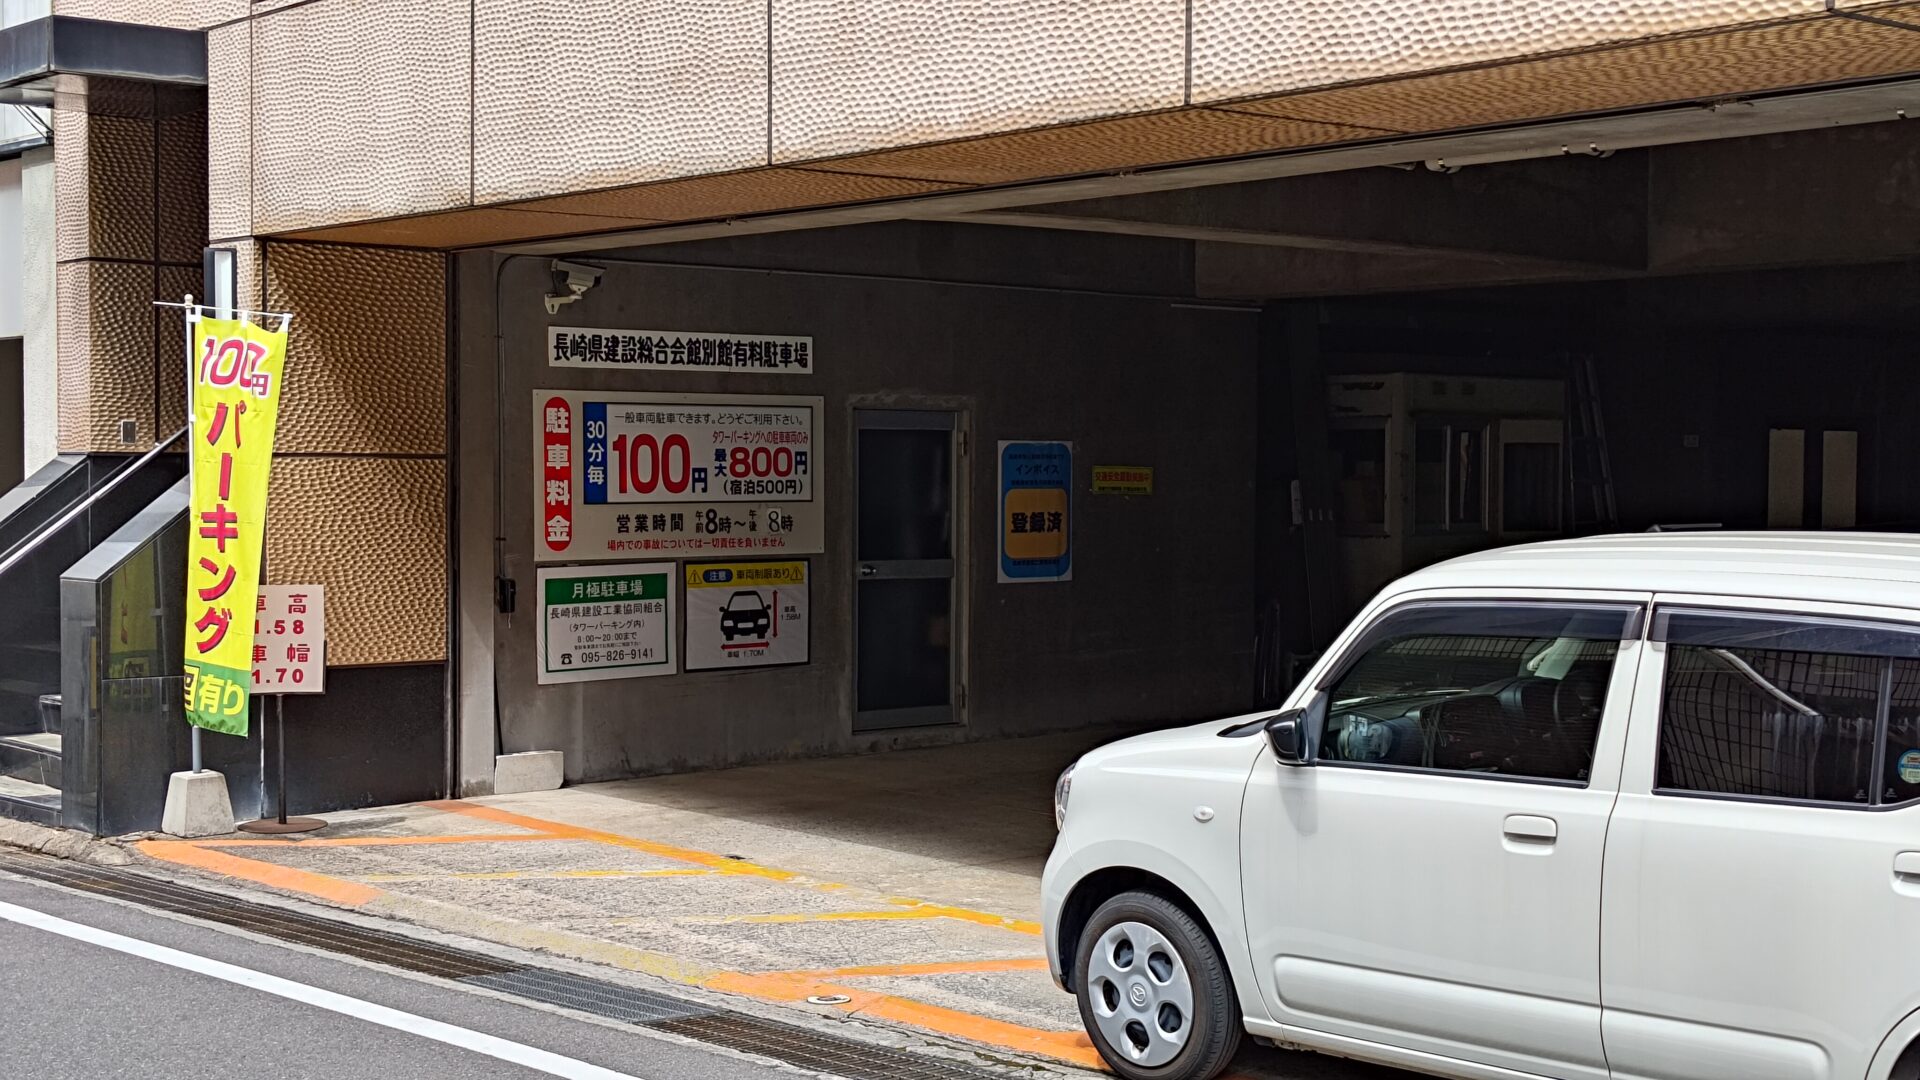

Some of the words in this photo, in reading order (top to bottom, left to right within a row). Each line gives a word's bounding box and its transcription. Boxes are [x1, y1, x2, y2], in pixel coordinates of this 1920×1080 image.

[553, 333, 809, 368] 長崎県建設総合会館別館有料駐車場
[200, 338, 269, 396] 100円
[586, 421, 605, 485] 30分毎
[612, 433, 708, 494] 100円
[1016, 464, 1060, 475] インボイス
[545, 407, 570, 542] 駐車料金
[723, 479, 803, 495] (宿泊500円)
[195, 400, 248, 654] パーキング
[616, 513, 684, 533] 営業時間
[1011, 511, 1063, 533] 登録済
[607, 537, 786, 551] 場内での事故については一切責任を負いません
[572, 579, 643, 599] 月極駐車場
[550, 602, 663, 619] 長崎県建設工業協同組合
[581, 648, 654, 663] 095-826-9141
[251, 668, 305, 684] 1.70
